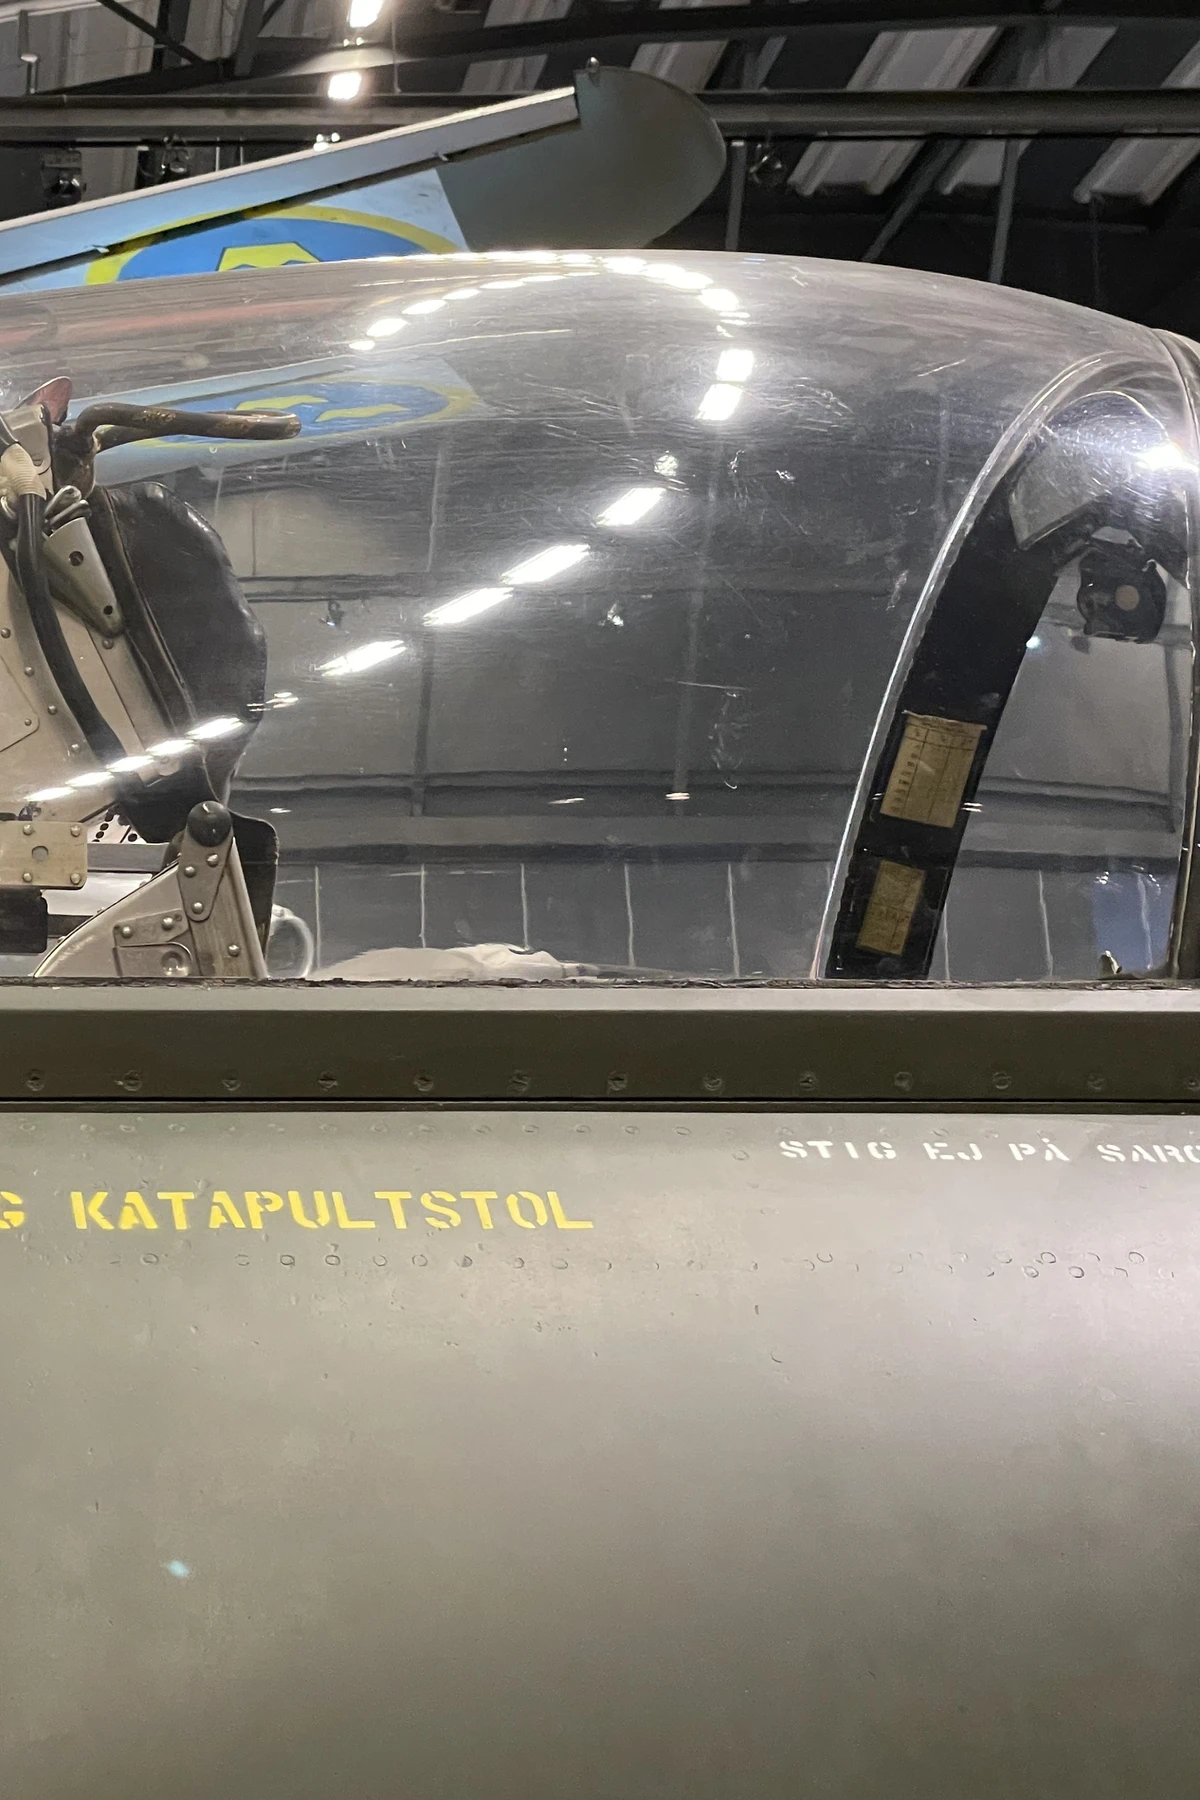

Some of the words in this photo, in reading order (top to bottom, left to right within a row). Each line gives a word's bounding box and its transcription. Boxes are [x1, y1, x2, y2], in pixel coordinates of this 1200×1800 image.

[779, 1141, 897, 1161] STIG
[922, 1142, 984, 1161] EJ
[1008, 1138, 1071, 1162] PÅ
[70, 1190, 595, 1230] KATAPULTSTOL
